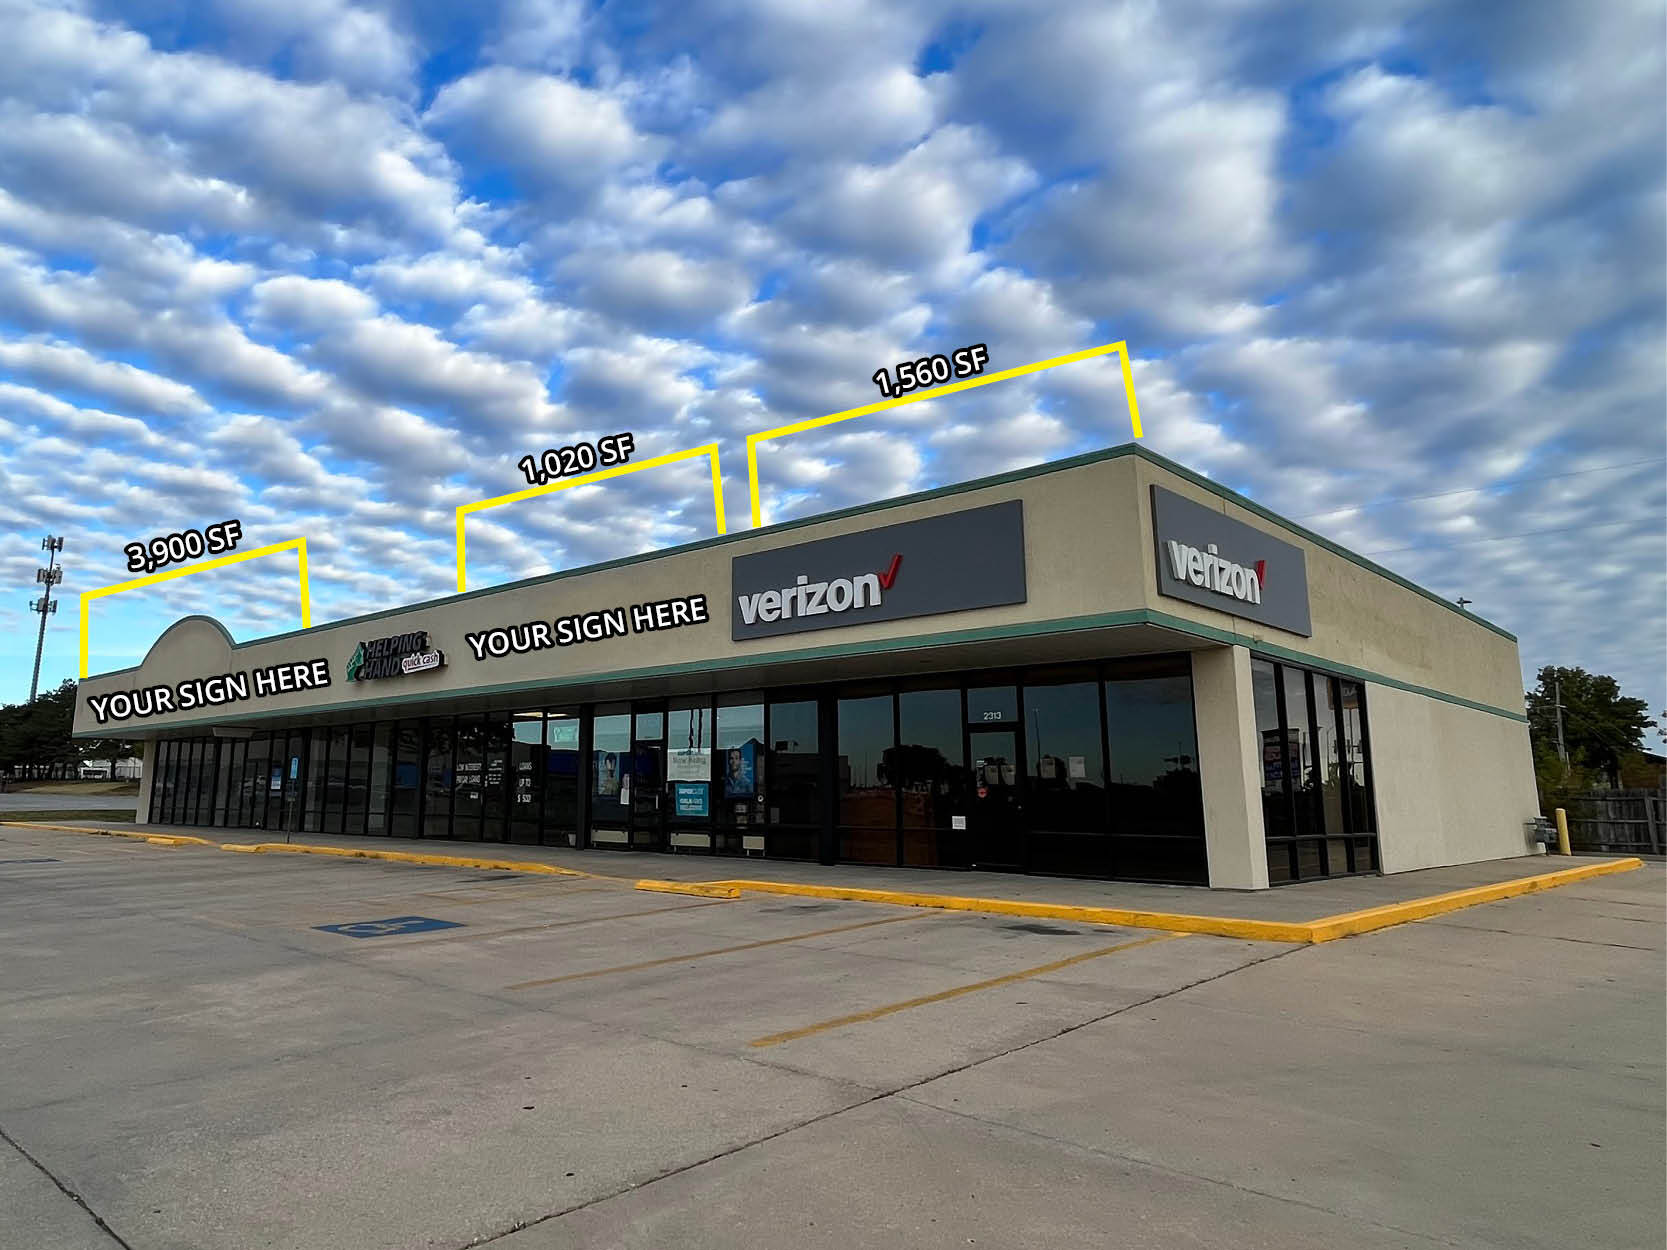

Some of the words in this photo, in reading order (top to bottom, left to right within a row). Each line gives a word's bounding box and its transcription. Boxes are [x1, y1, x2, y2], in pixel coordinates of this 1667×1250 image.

[1167, 540, 1261, 605] verizon
[738, 575, 882, 625] verizon
[367, 631, 428, 659] HELPING
[365, 656, 401, 680] HAND
[402, 653, 421, 671] quick
[422, 651, 440, 665] cash
[983, 711, 1002, 721] 2313
